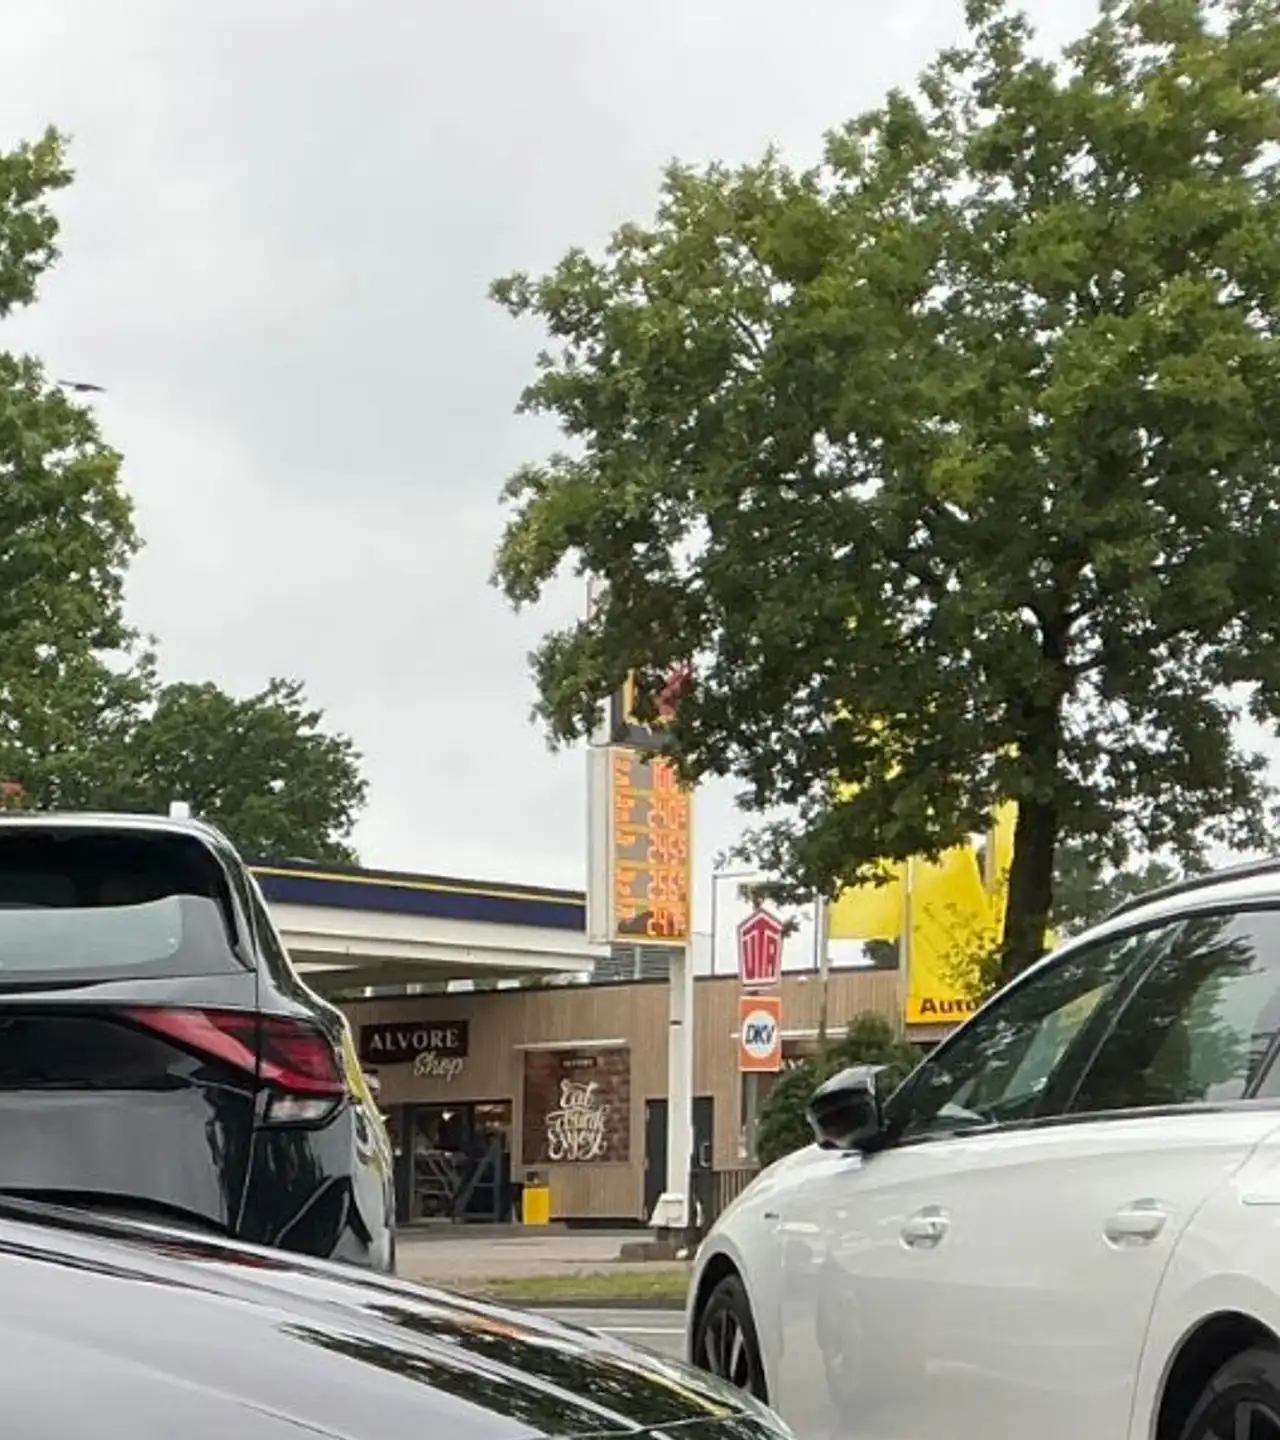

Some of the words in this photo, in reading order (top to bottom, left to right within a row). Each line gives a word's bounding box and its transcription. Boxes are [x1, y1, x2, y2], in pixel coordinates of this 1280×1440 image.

[369, 1028, 459, 1051] ALVORE
[745, 1024, 775, 1045] DKV
[414, 1050, 463, 1082] Shop
[560, 1079, 599, 1108] Eat
